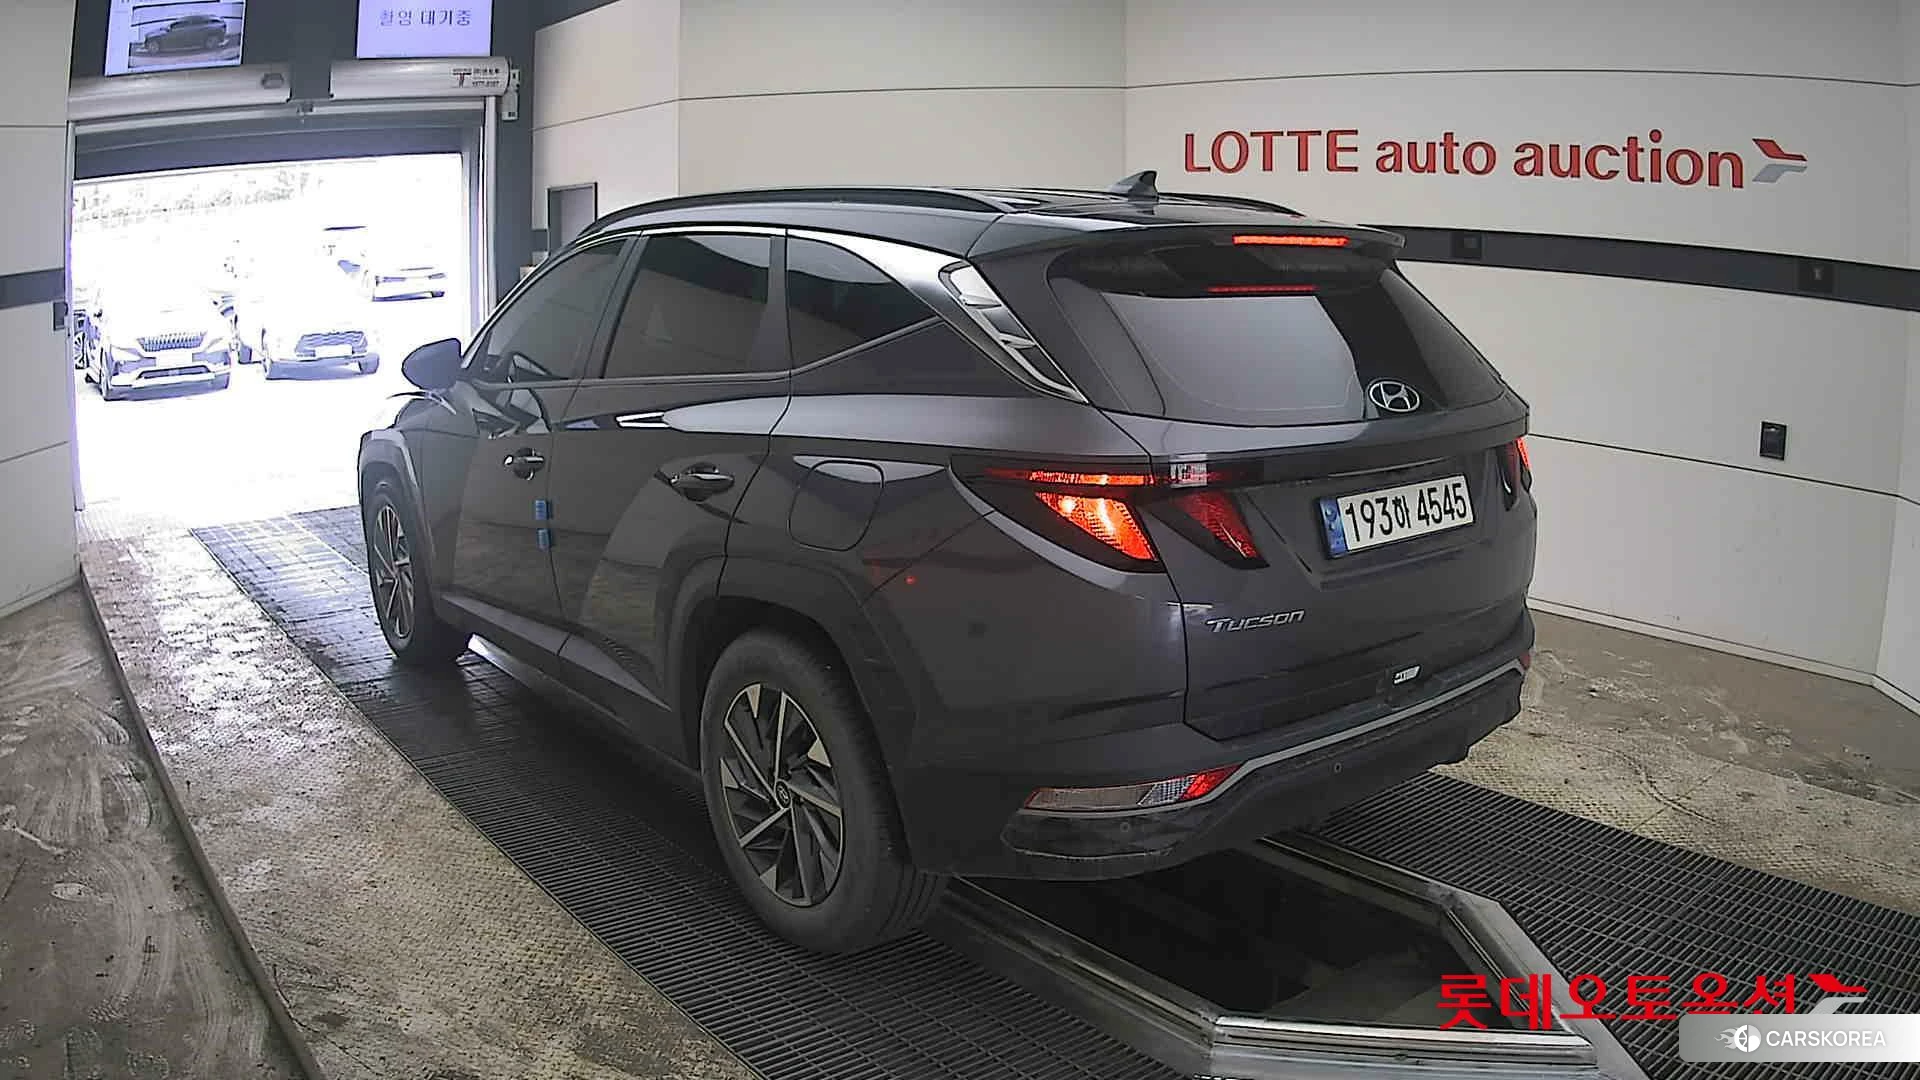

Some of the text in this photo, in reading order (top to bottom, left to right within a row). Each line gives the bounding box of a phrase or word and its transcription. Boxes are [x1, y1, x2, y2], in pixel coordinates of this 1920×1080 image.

[420, 9, 472, 26] 대기중
[1184, 128, 1744, 189] LOTTE auto auction
[1345, 482, 1467, 542] 193하 4545
